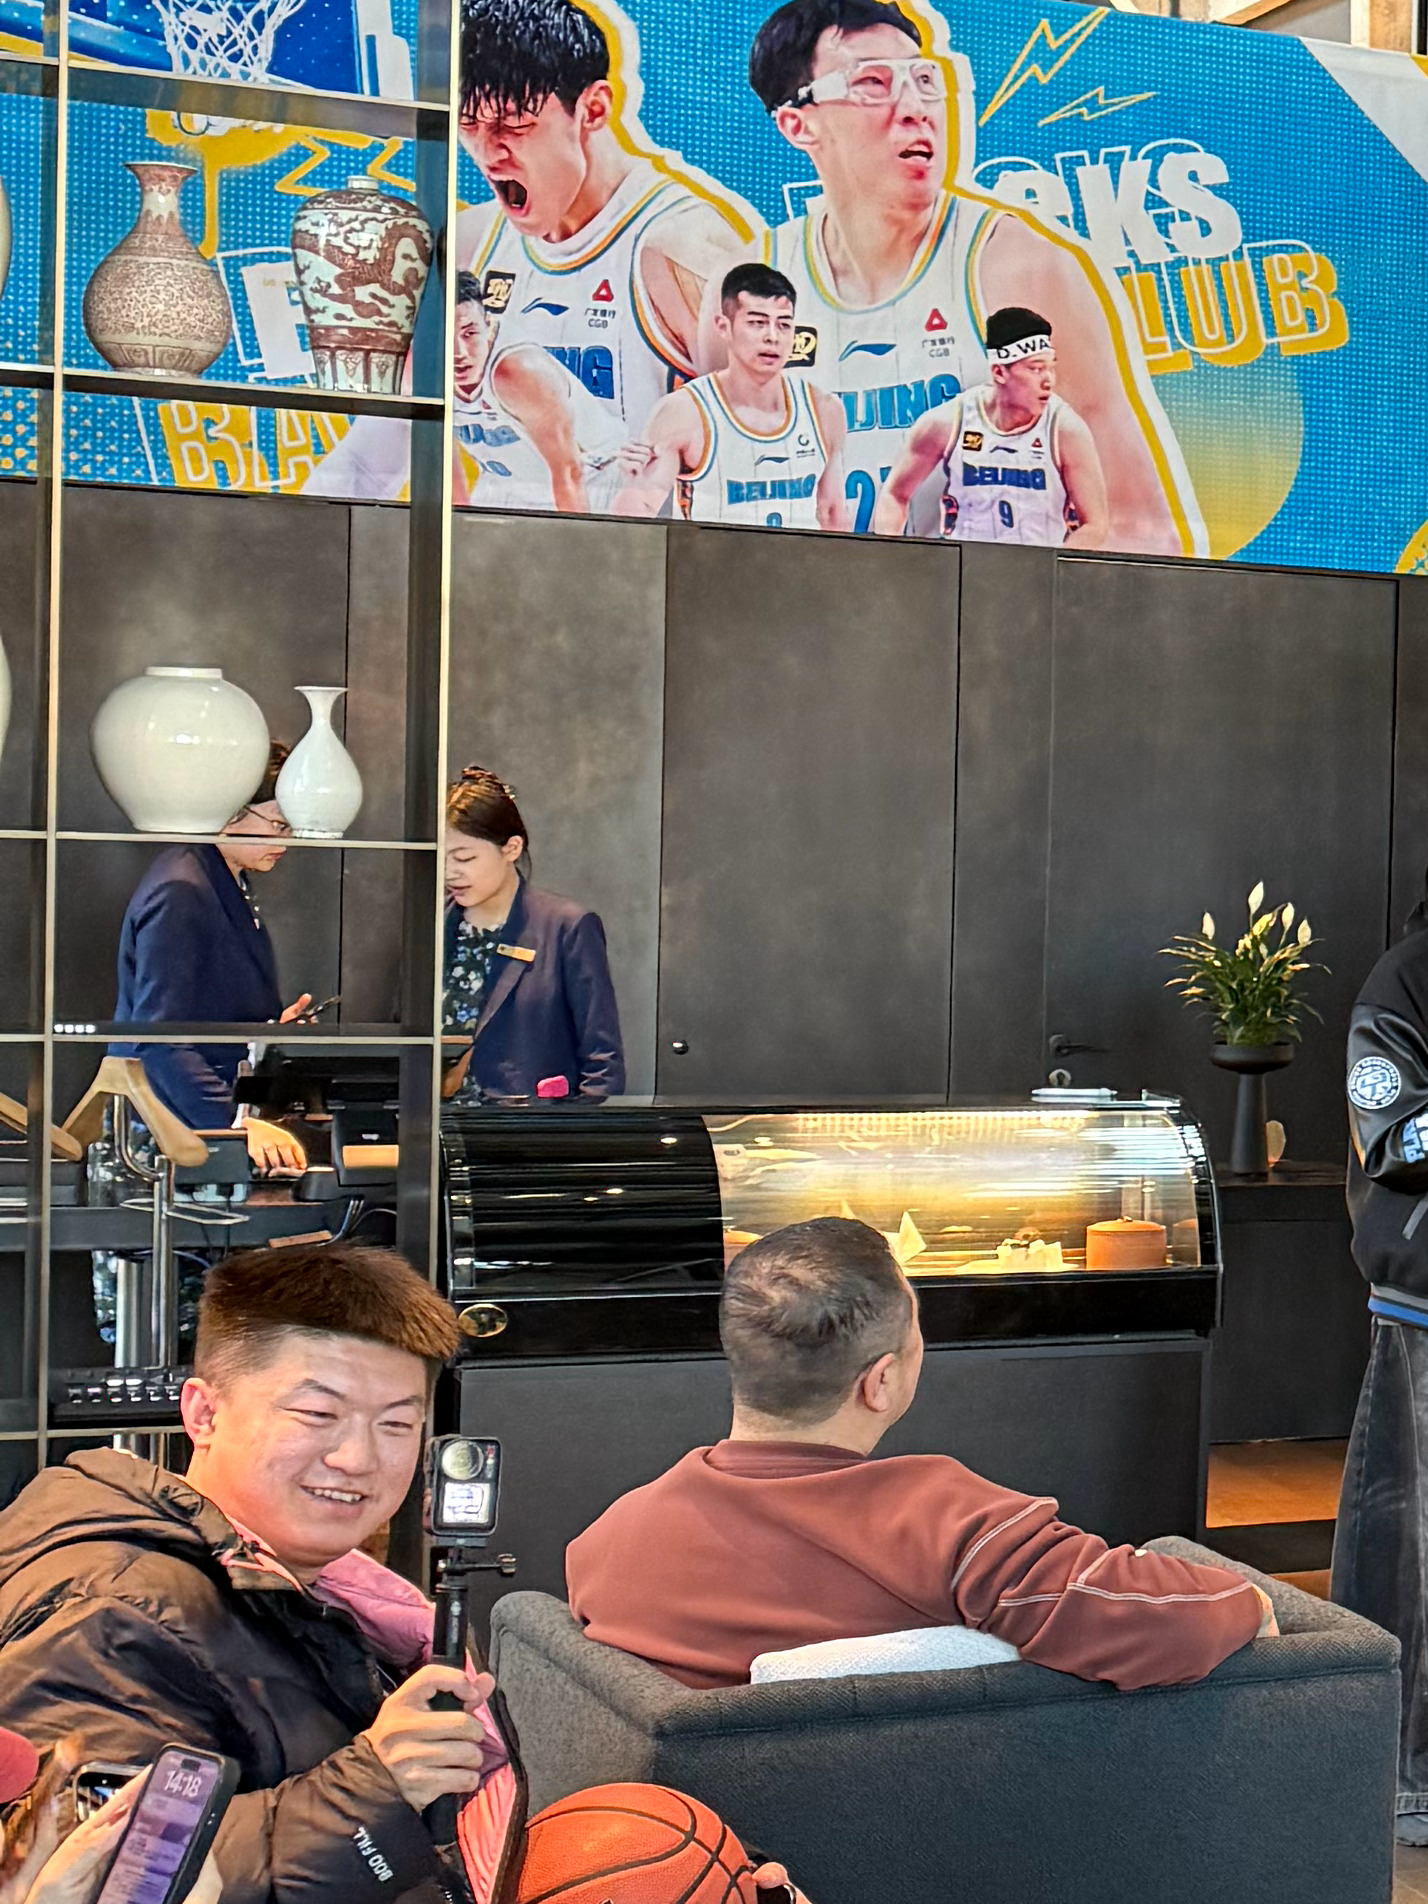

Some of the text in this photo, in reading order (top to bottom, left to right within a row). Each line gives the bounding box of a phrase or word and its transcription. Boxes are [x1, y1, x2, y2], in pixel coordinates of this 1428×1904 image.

[1120, 239, 1349, 374] LUB
[997, 500, 1015, 528] 9
[353, 1826, 377, 1856] FILL
